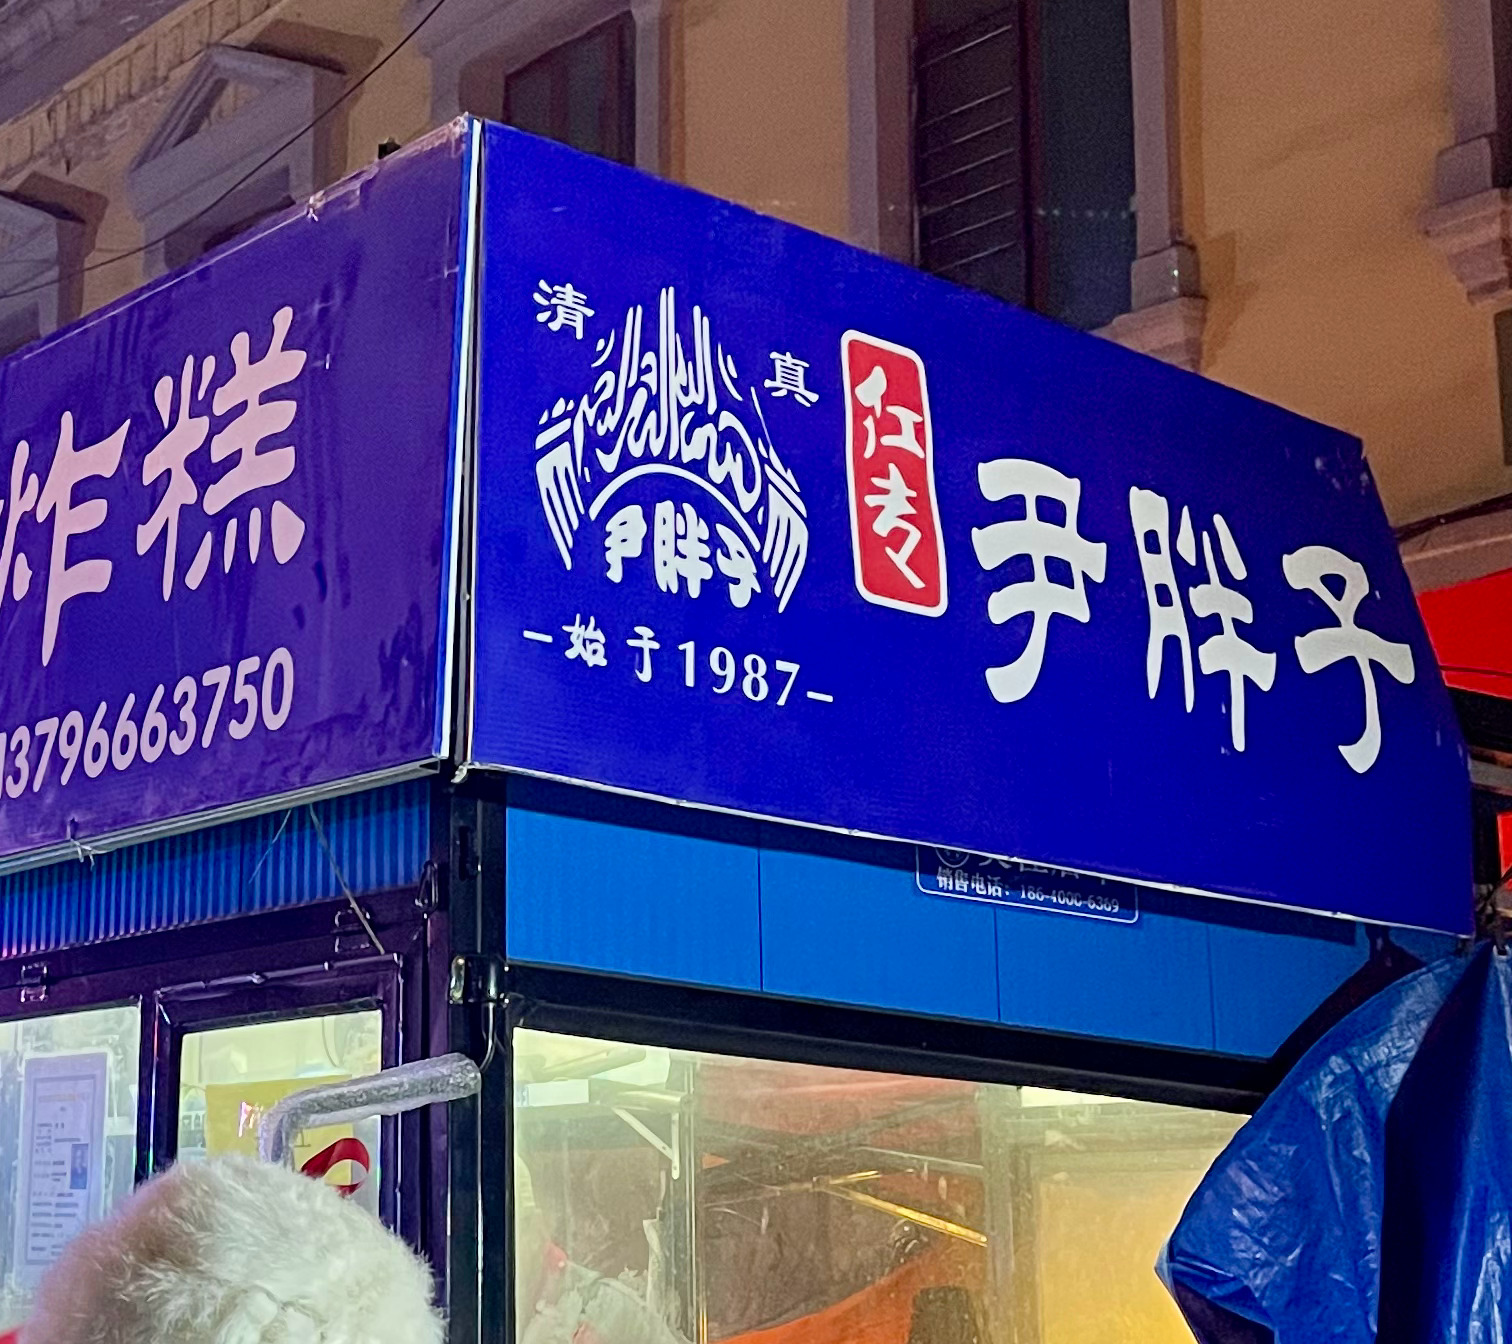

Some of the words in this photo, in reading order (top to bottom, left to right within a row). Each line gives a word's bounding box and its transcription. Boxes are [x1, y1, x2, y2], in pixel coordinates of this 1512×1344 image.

[532, 279, 595, 340] 清
[763, 351, 820, 408] 真
[604, 499, 762, 609] 尹胖子
[971, 458, 1416, 774] 尹胖子
